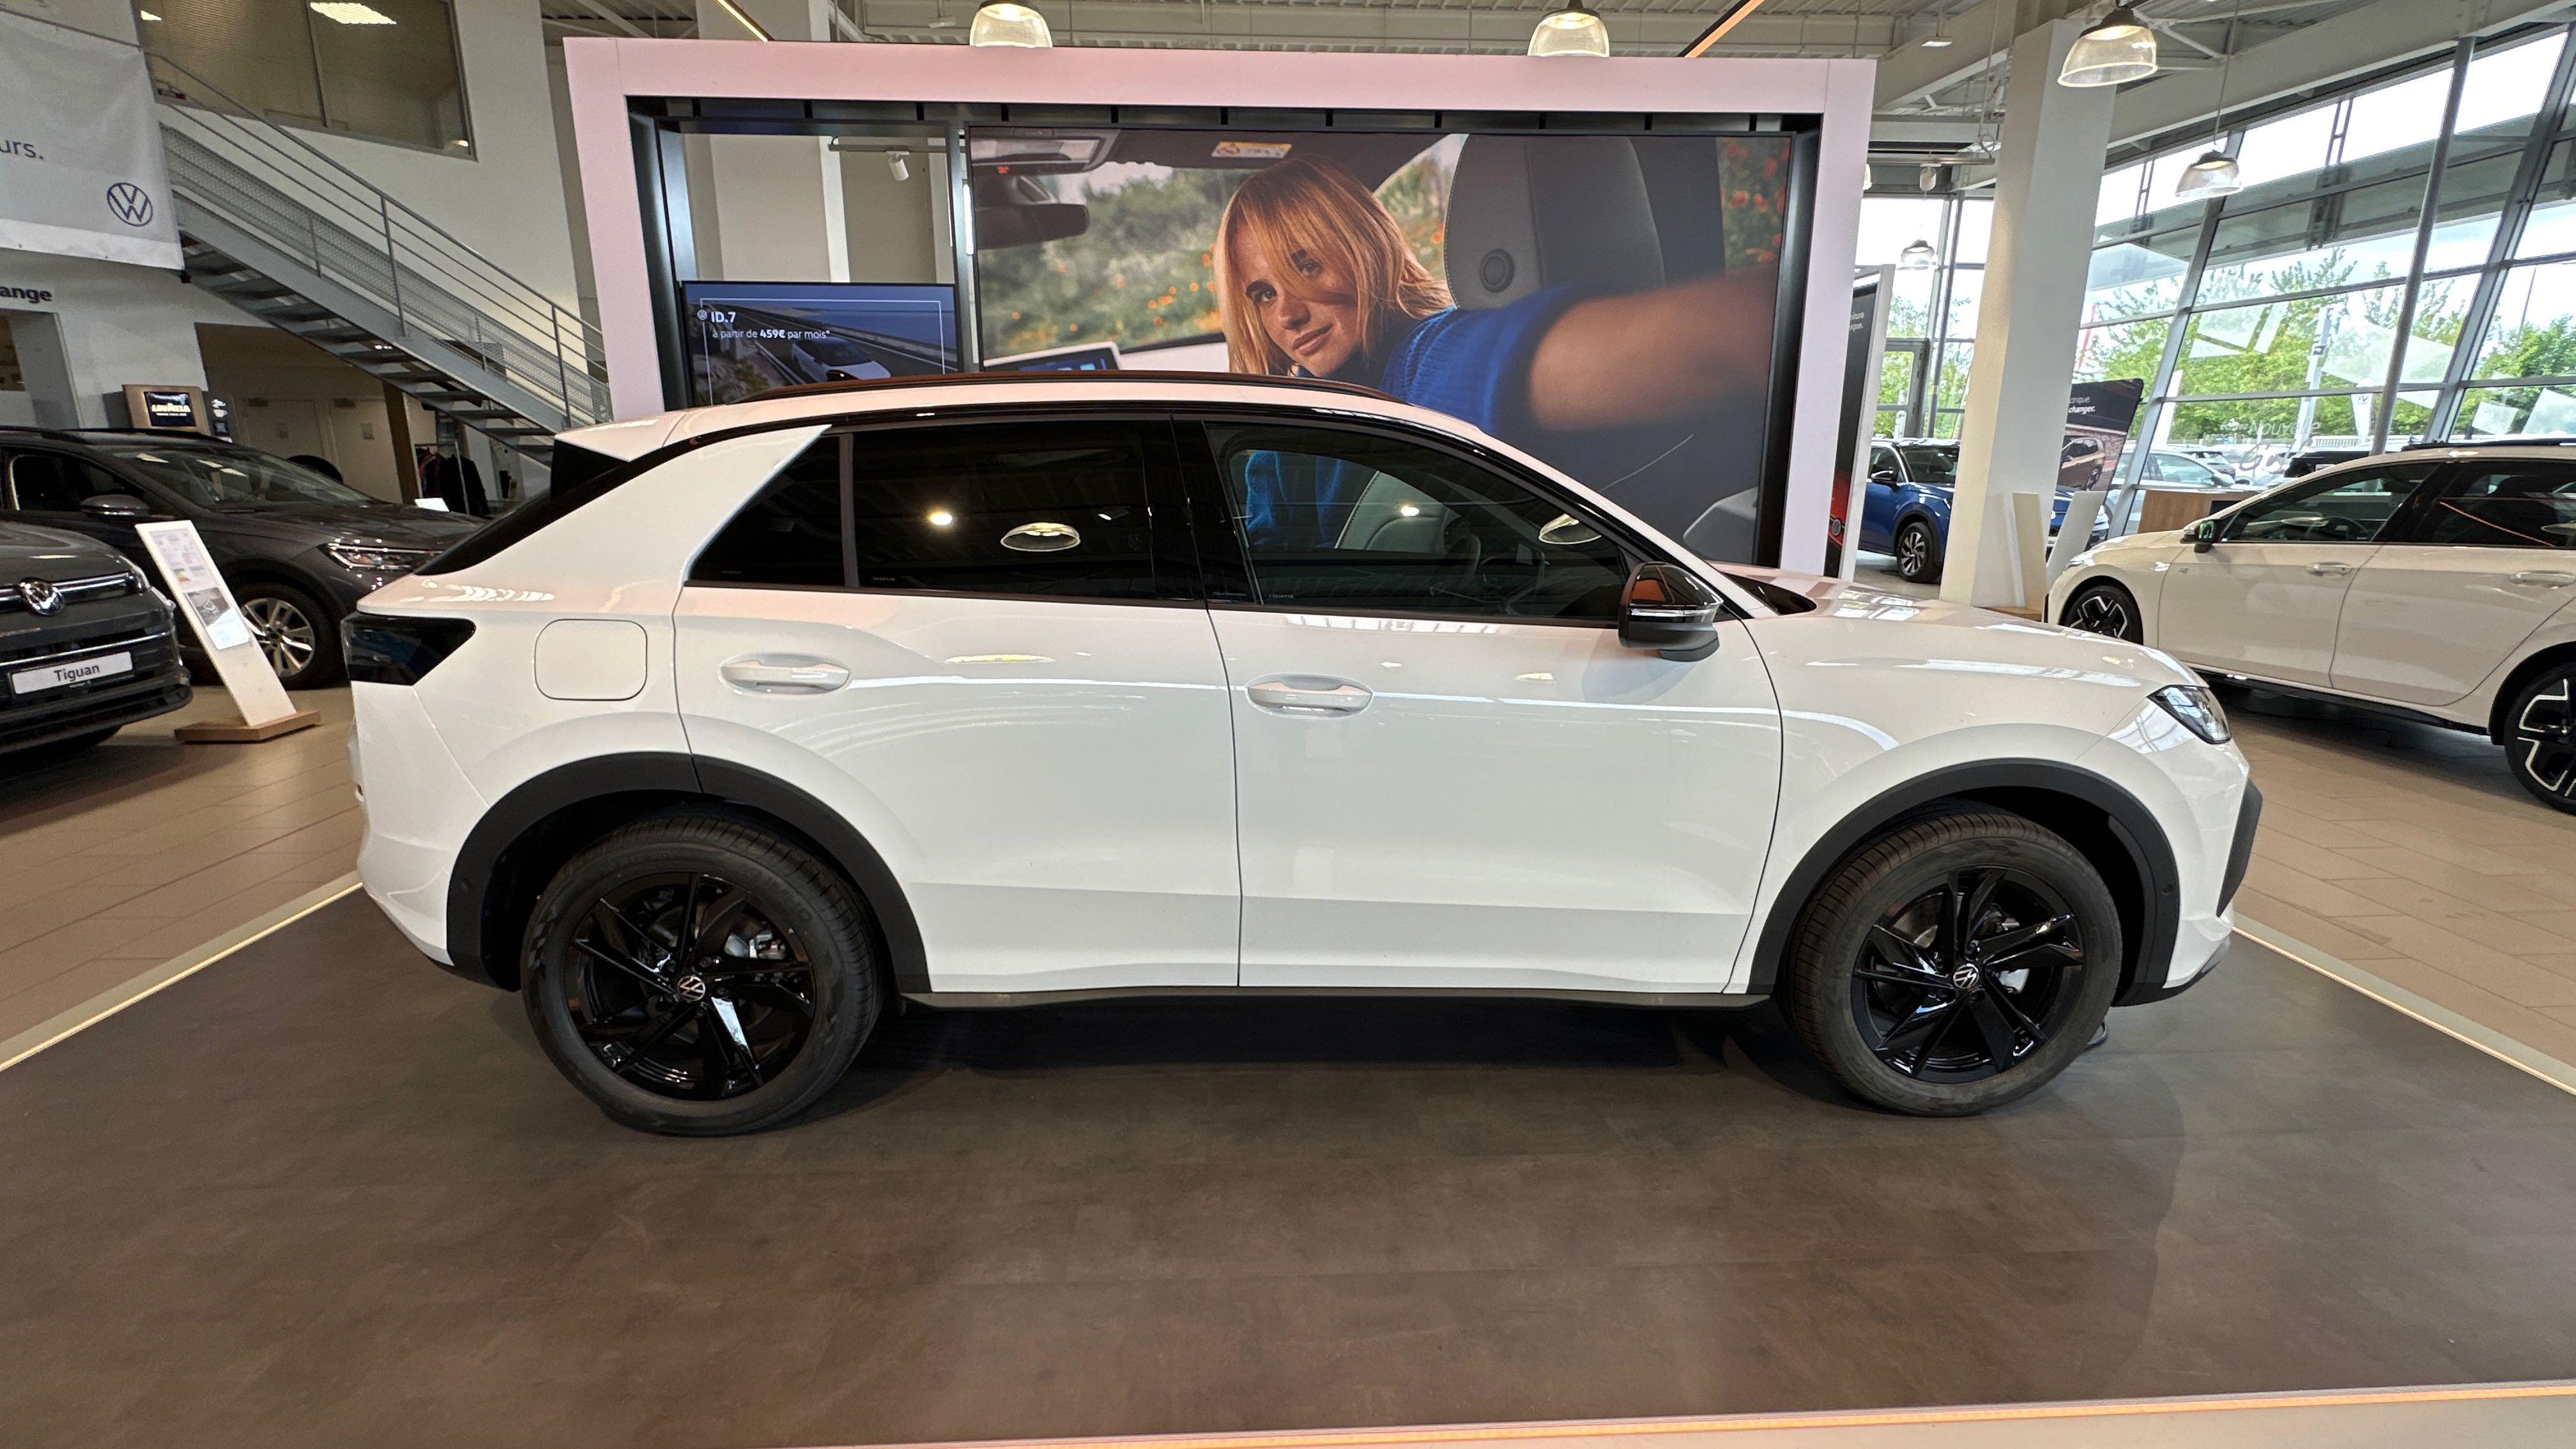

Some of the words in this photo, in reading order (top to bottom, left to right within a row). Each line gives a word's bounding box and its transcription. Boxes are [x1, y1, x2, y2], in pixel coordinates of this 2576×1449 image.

[711, 311, 736, 323] ID.7
[721, 329, 744, 339] partir
[746, 328, 758, 338] de
[760, 329, 786, 339] 459€
[787, 331, 803, 340] par
[54, 664, 100, 682] Tiguan
